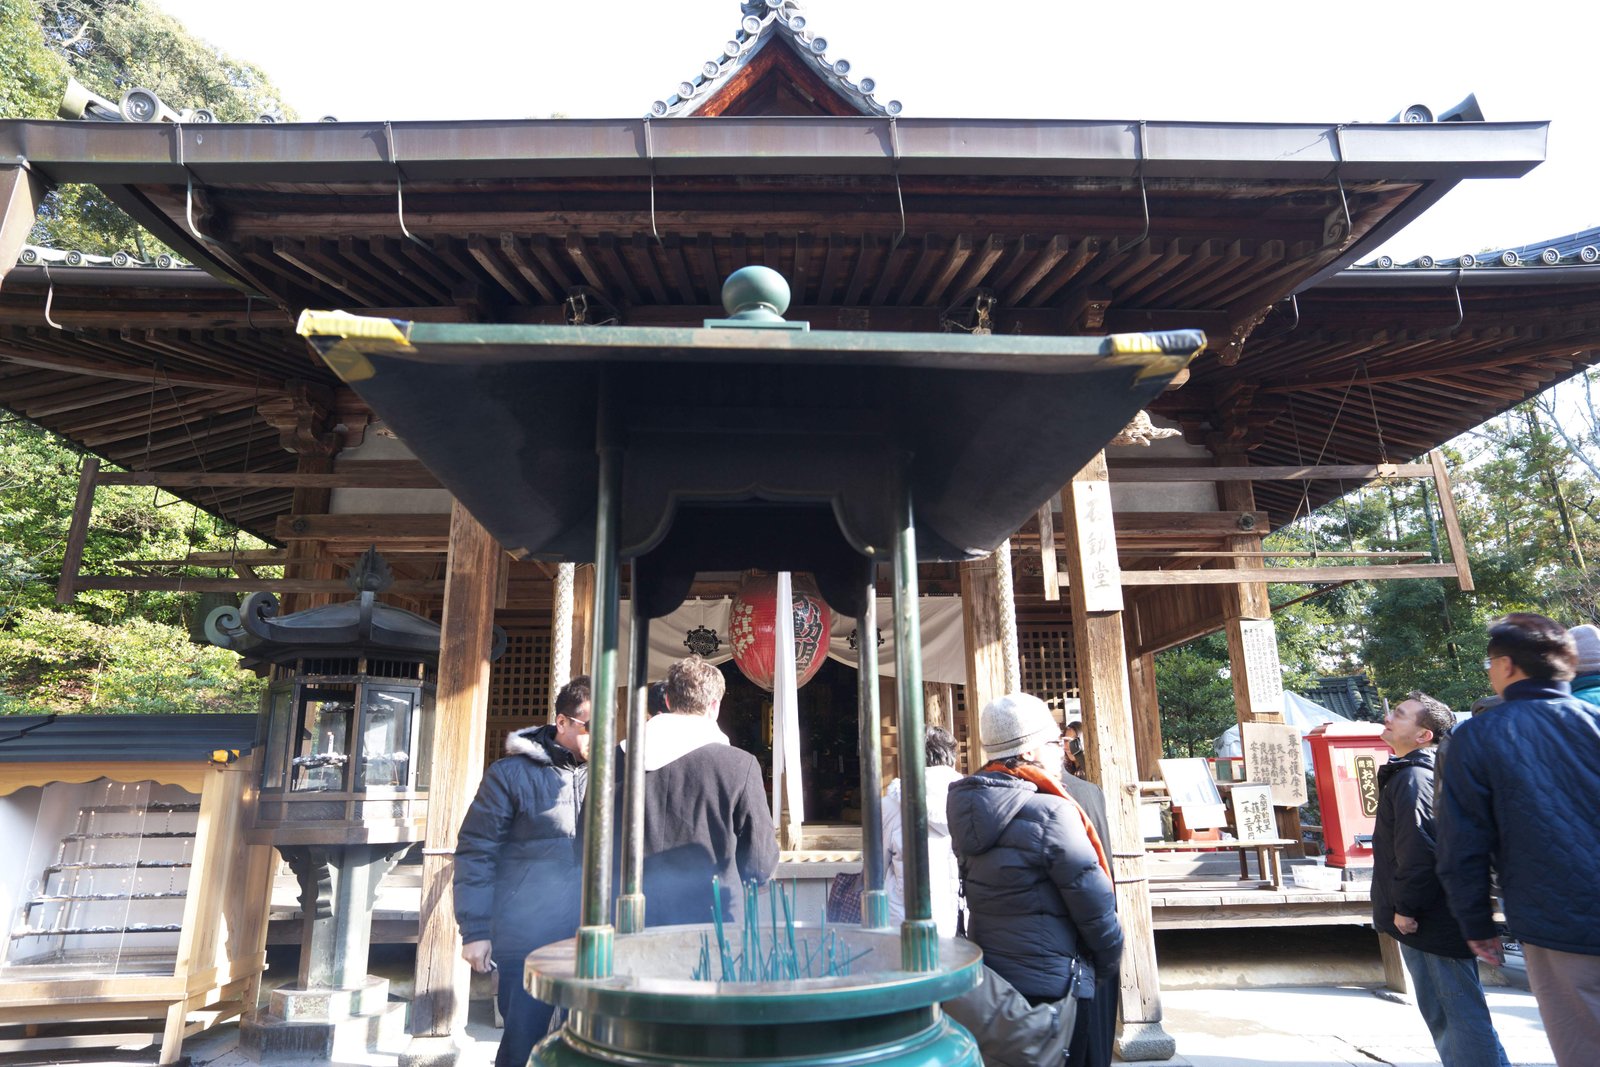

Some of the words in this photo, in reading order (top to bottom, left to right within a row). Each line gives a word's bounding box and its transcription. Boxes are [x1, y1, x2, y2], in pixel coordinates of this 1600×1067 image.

[1084, 497, 1111, 589] 不動堂
[1361, 769, 1379, 813] おみくじ
[1251, 801, 1266, 834] 護摩木
